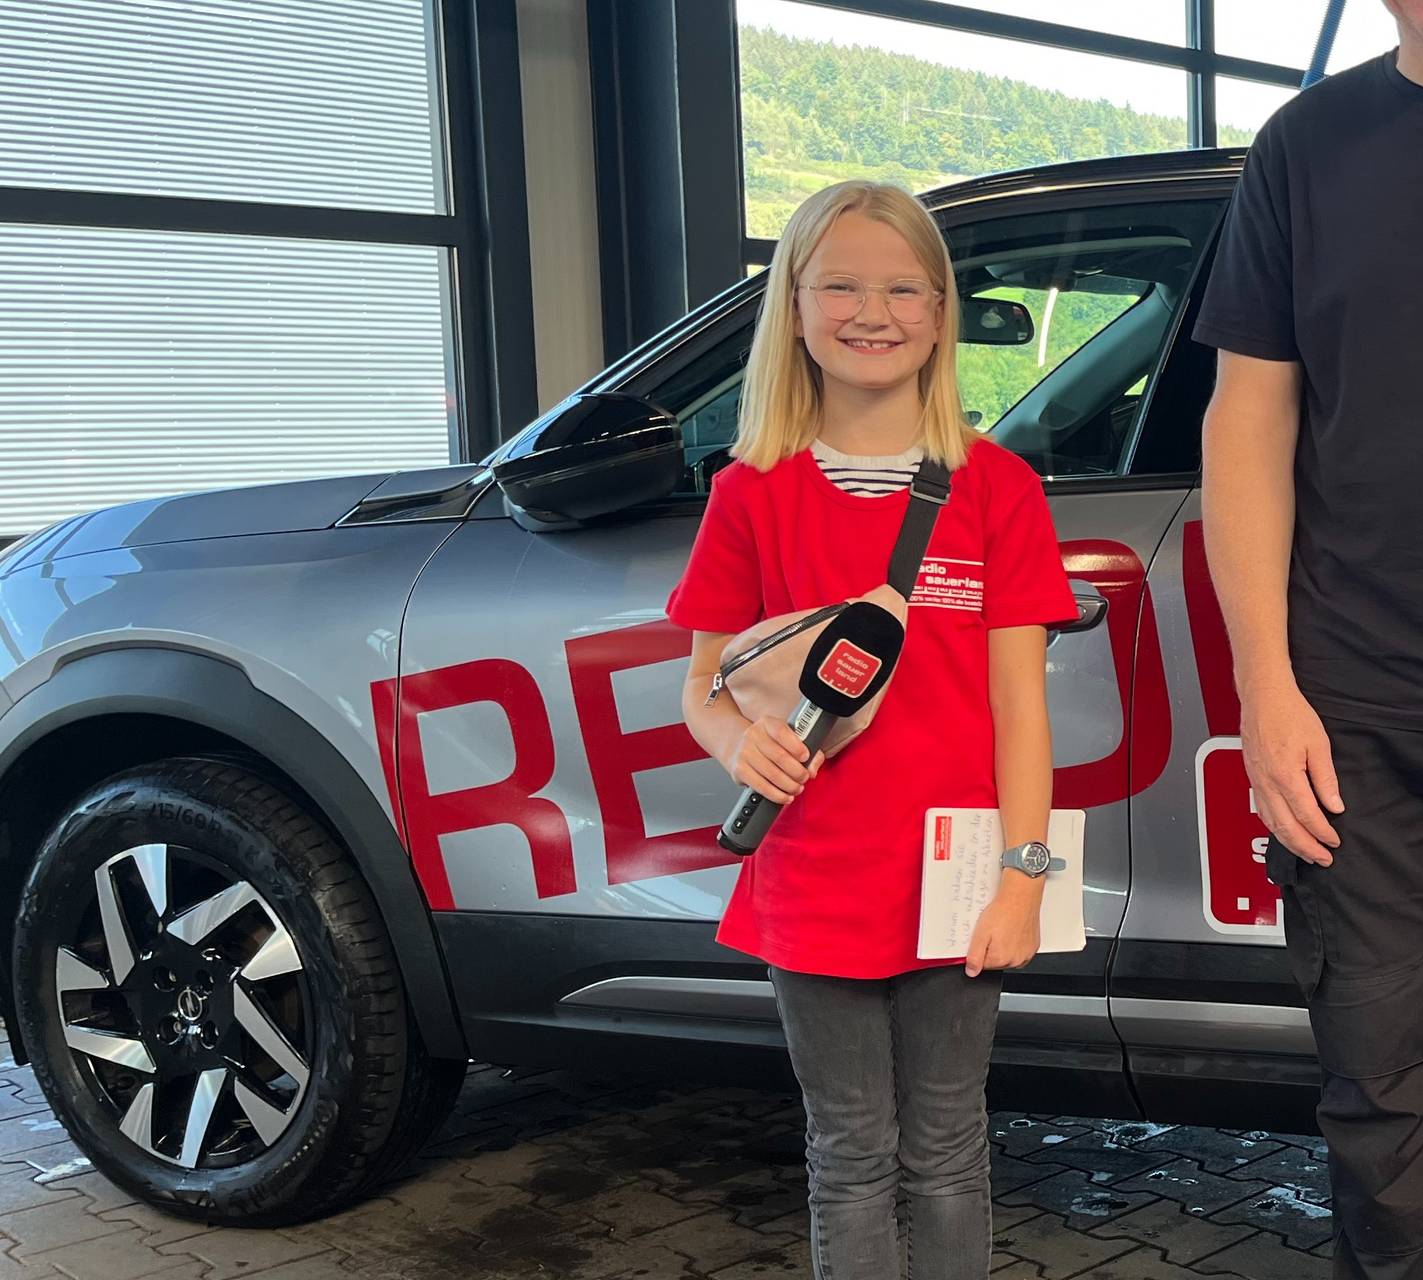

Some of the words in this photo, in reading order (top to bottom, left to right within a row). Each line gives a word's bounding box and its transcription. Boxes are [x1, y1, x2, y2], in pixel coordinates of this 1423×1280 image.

[918, 562, 947, 575] adio
[925, 575, 984, 590] sauerla
[836, 658, 865, 677] sauer
[842, 652, 869, 670] radio
[834, 667, 858, 683] land
